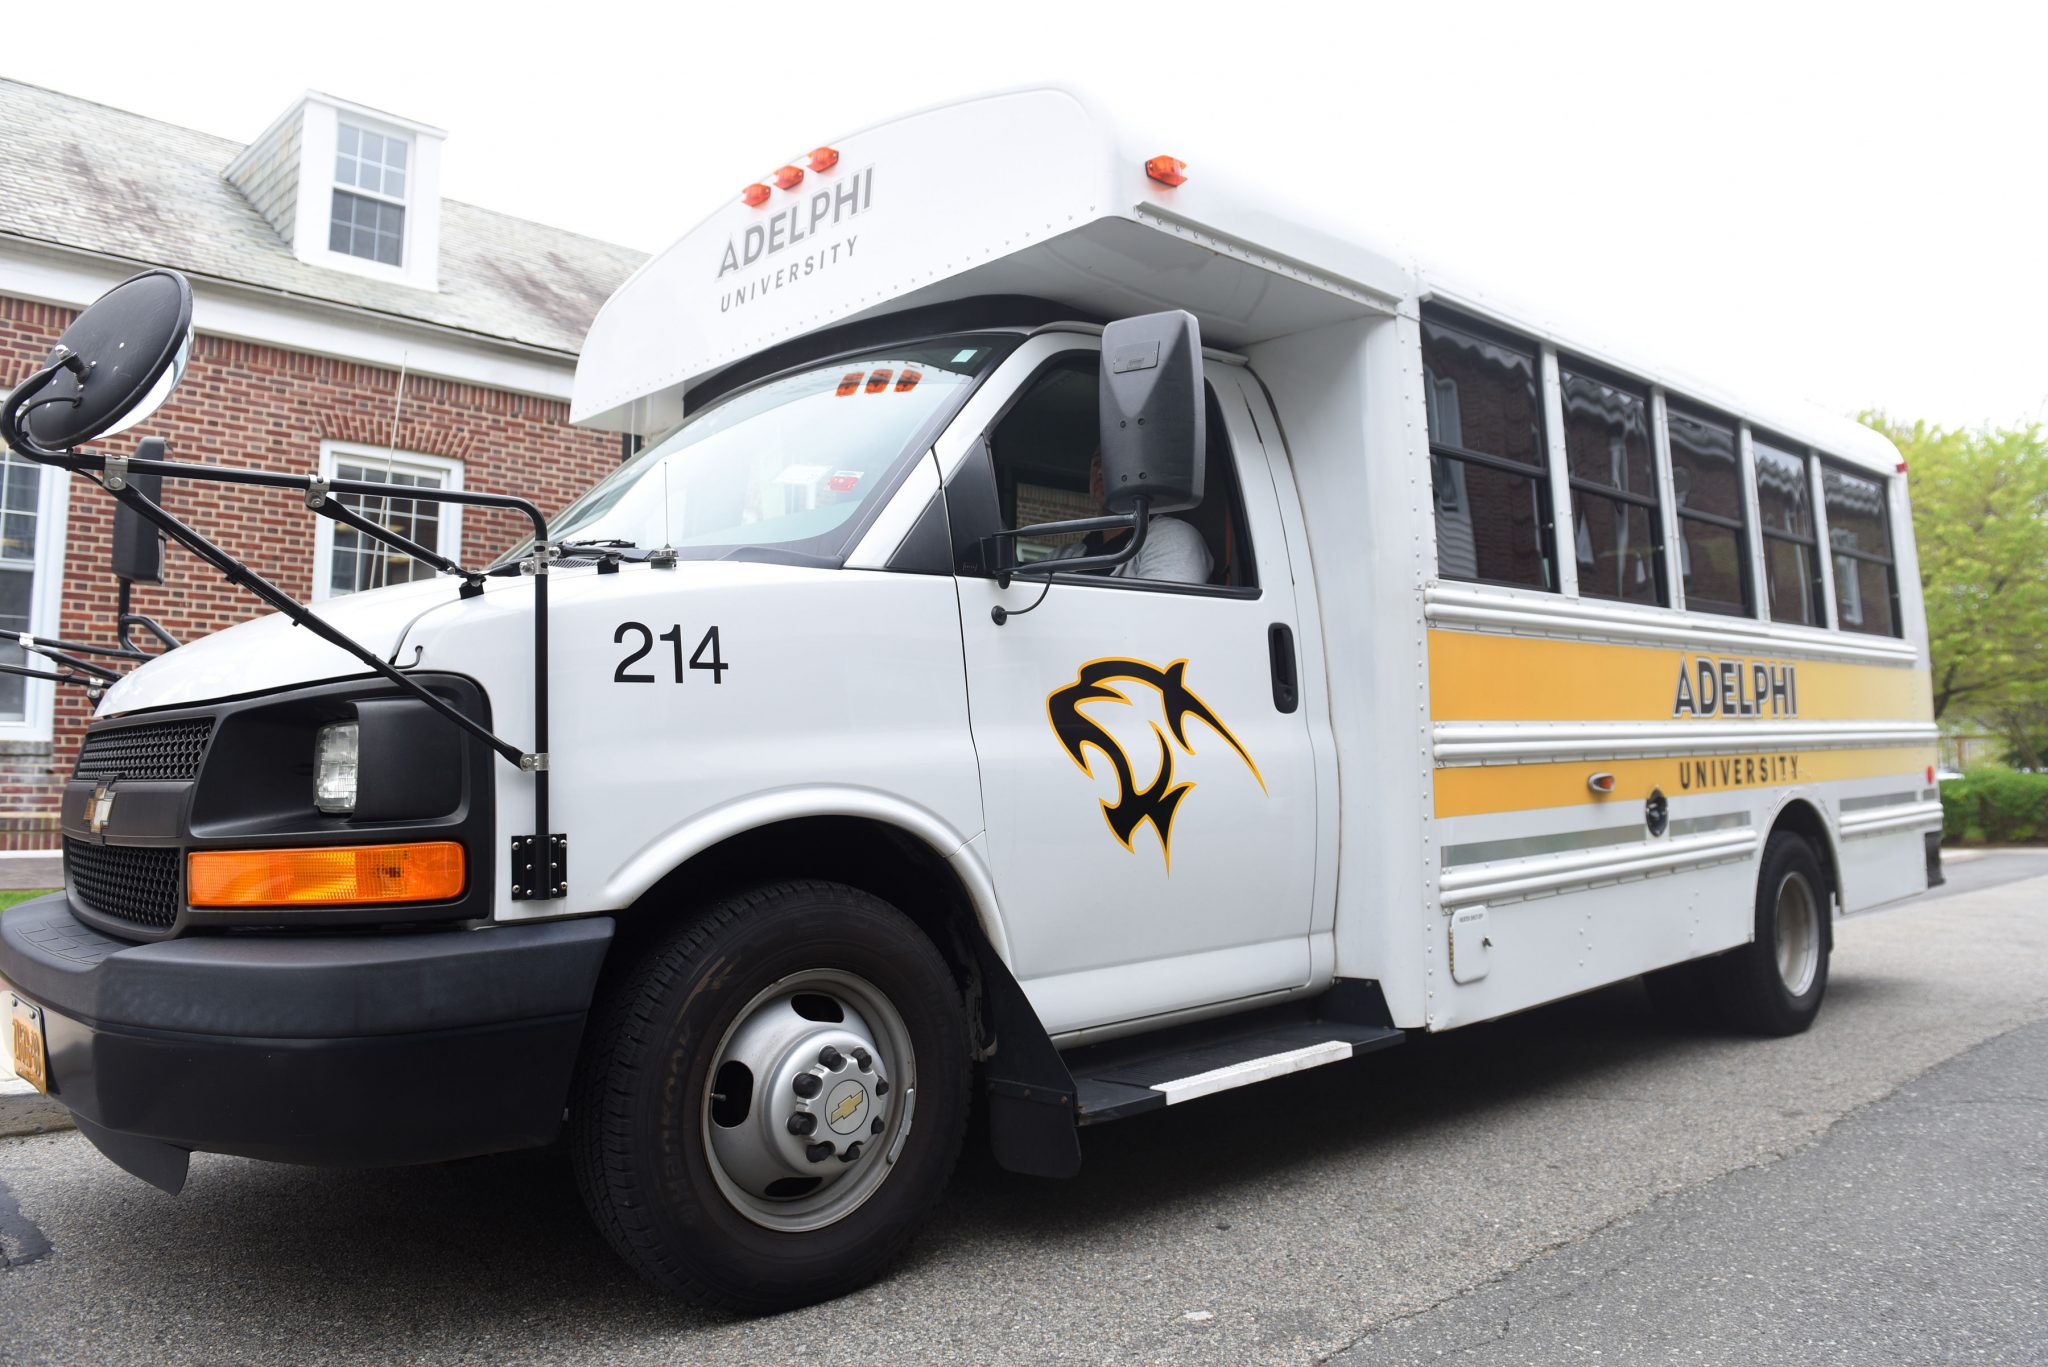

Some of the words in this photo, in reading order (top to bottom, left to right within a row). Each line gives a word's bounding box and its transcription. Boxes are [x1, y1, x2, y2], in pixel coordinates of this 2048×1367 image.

[717, 166, 873, 278] ADELPHI
[720, 235, 857, 313] UNIVERSITY
[613, 621, 729, 685] 214
[1673, 655, 1798, 718] ADELPHI
[1680, 755, 1799, 790] UNIVERSITY
